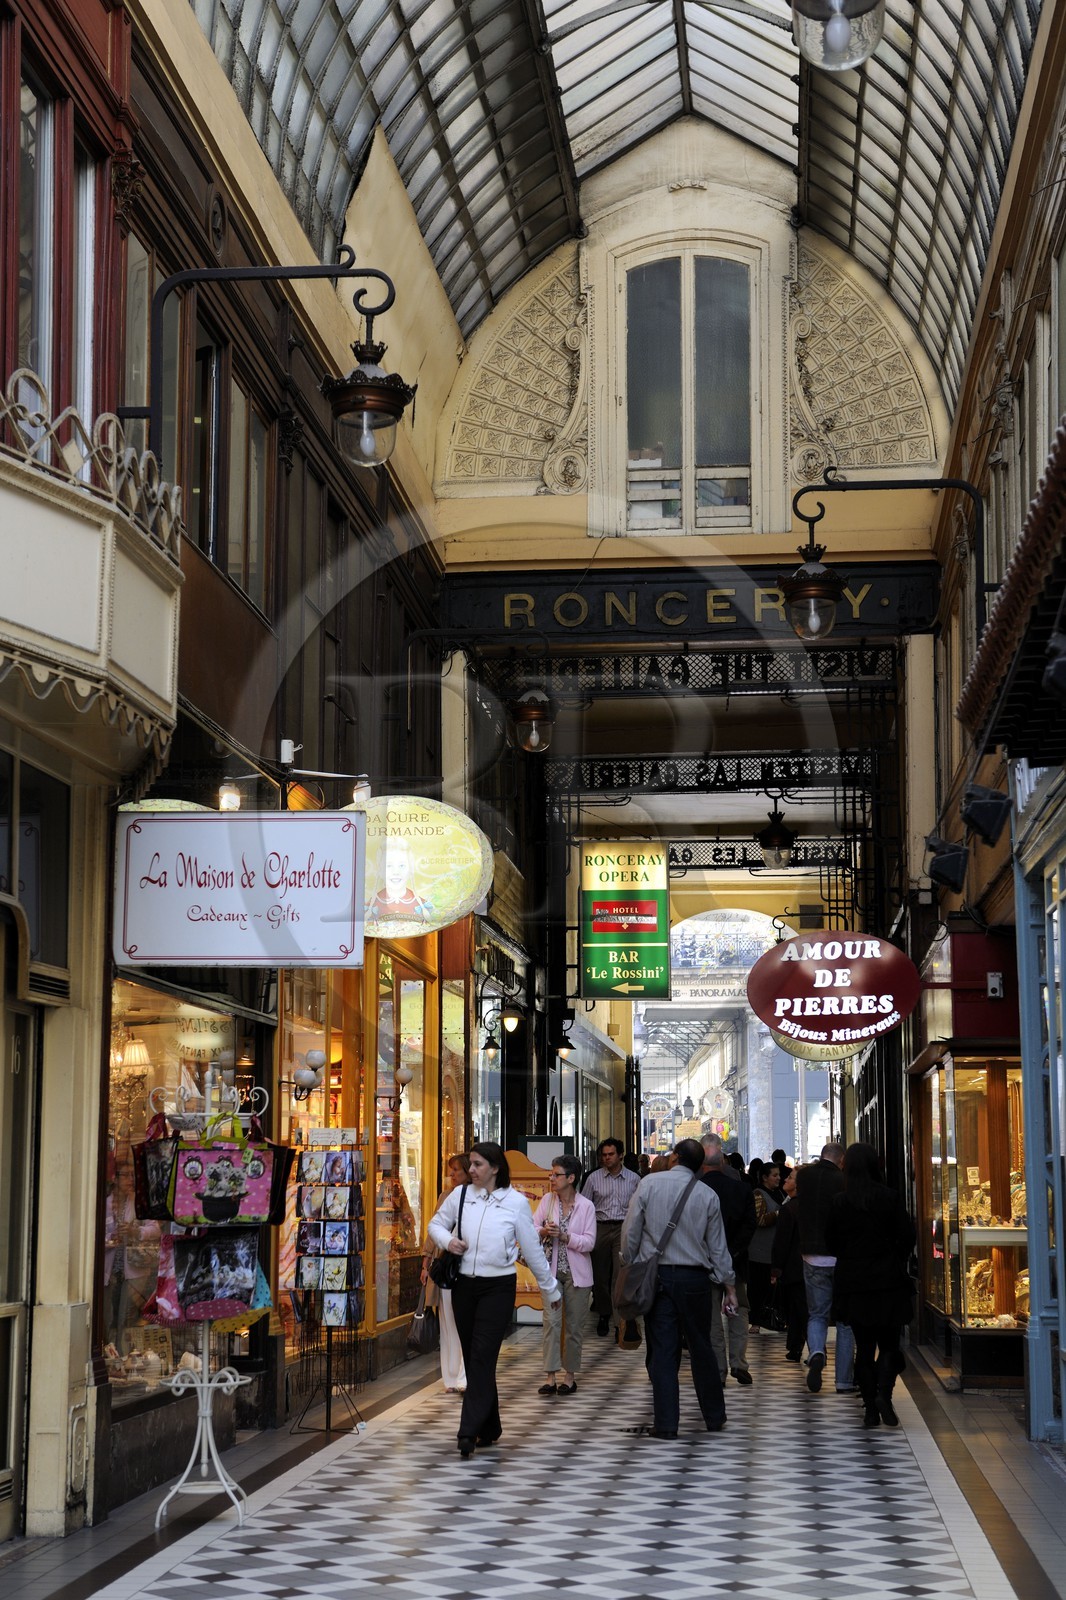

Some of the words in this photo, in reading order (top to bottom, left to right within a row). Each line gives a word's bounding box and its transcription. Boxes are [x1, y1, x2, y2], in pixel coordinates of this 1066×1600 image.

[504, 583, 873, 628] RONCERY
[386, 810, 430, 824] CURE
[367, 826, 445, 837] URMANDE
[584, 854, 664, 866] RONCERAY
[139, 853, 168, 889] La
[175, 852, 234, 891] Maison
[240, 852, 256, 889] de
[263, 851, 341, 899] Charlotte
[599, 871, 650, 882] OPERA
[186, 904, 248, 930] Cadeaux
[266, 904, 300, 929] Gifts
[608, 951, 640, 963] BAR
[781, 940, 882, 962] AMOUR
[813, 968, 851, 988] DE
[690, 988, 748, 998] PANORAMAS
[774, 994, 894, 1017] PIERRES
[778, 1018, 828, 1041] Bijoux
[831, 1010, 901, 1041] Mineraux
[11, 1034, 21, 1075] 16
[779, 1035, 814, 1056] BIJOUX
